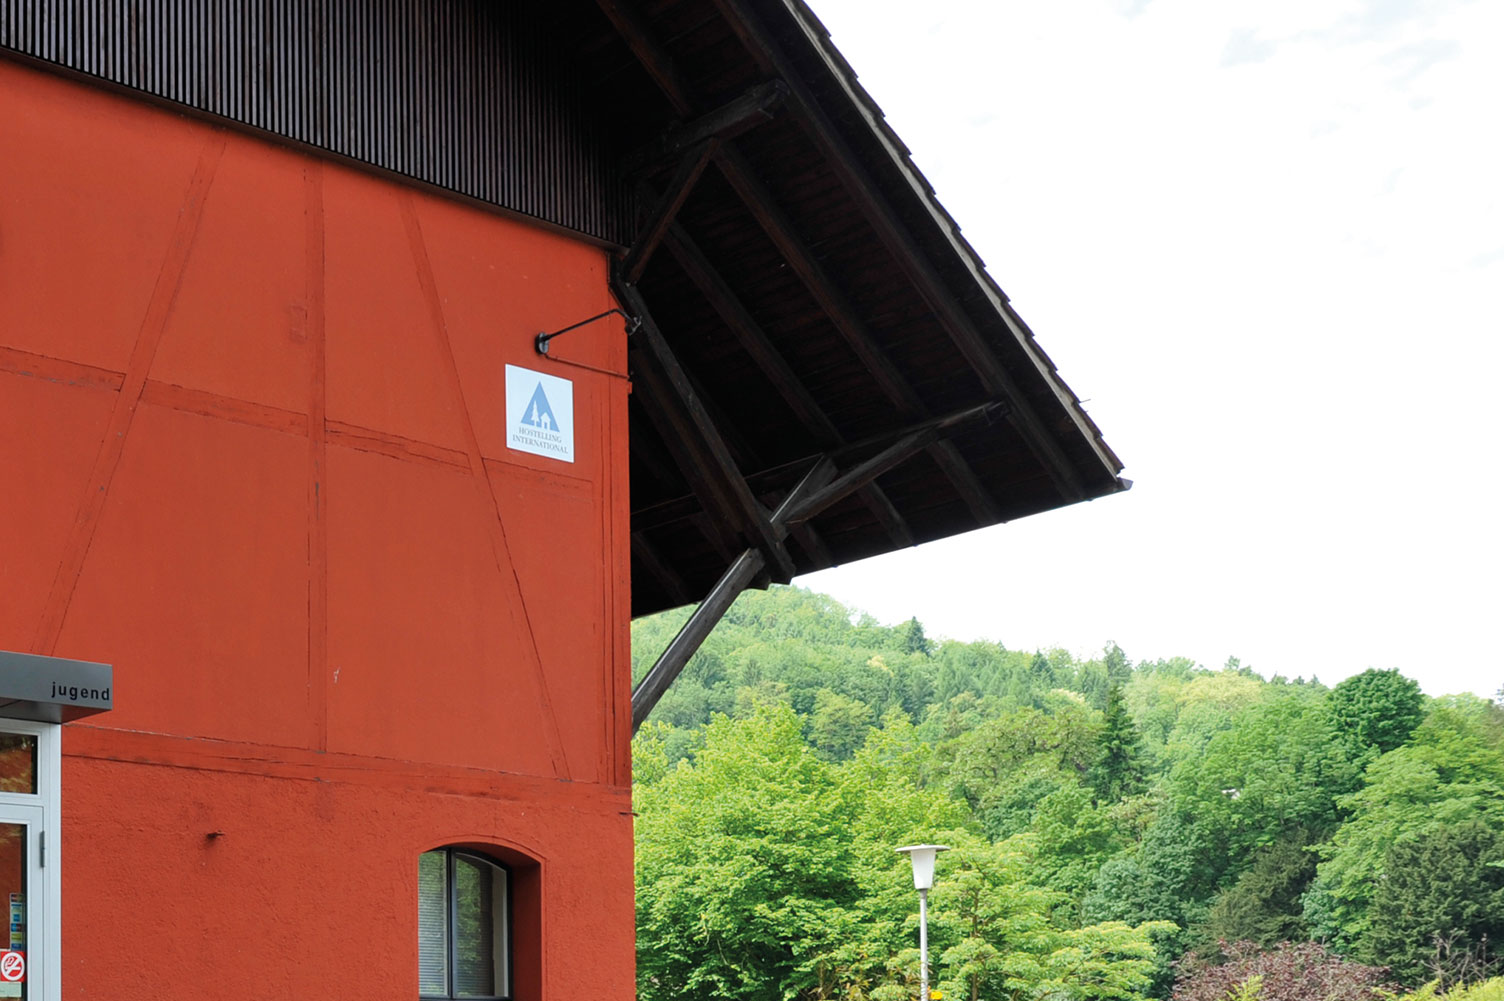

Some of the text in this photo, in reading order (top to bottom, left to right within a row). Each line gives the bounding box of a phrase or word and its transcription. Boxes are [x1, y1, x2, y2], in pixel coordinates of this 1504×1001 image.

[512, 434, 568, 454] INTERNATIONAL
[518, 427, 562, 443] HOSTELLING
[51, 681, 110, 700] jugend
